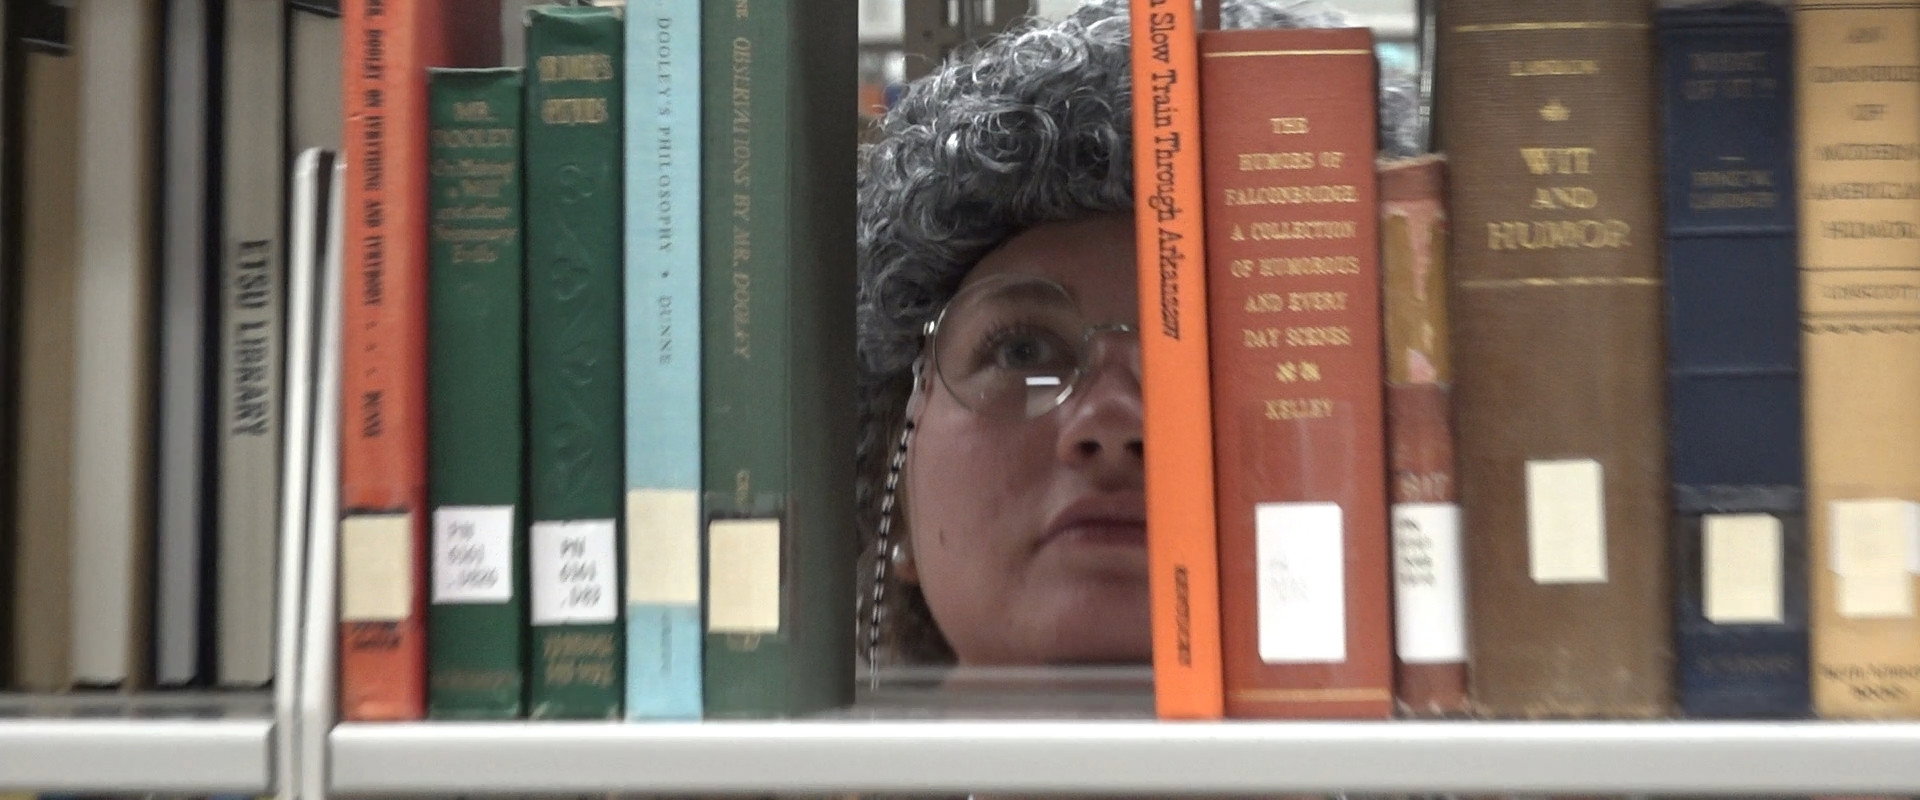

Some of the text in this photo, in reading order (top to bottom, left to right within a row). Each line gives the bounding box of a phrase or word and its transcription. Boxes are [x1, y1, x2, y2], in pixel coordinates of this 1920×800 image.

[1149, 13, 1176, 63] Slow
[365, 29, 383, 81] DOOLEY
[365, 90, 382, 108] ON
[732, 37, 751, 187] OBSERVATIONS
[1152, 70, 1178, 128] Train
[1270, 117, 1309, 133] THE
[1319, 151, 1344, 168] OF
[1519, 146, 1597, 175] WIT
[658, 18, 671, 365] DOOLEY'S PHILOSOPHY DUNNE
[1148, 132, 1182, 222] Through
[732, 194, 748, 220] BY
[1530, 187, 1598, 209] AND
[364, 200, 382, 228] AND
[1230, 220, 1356, 241] A COLLECTION
[1487, 219, 1632, 250] HUMOR
[733, 226, 750, 268] MR.
[1230, 255, 1360, 278] OF HUMOROUS
[1159, 228, 1185, 340] Arkansaw
[733, 273, 750, 360] DOOLEY
[1245, 291, 1348, 313] AND EVERY
[232, 240, 269, 437] ETSU LIBRARY
[1243, 326, 1351, 348] DAY SCENES
